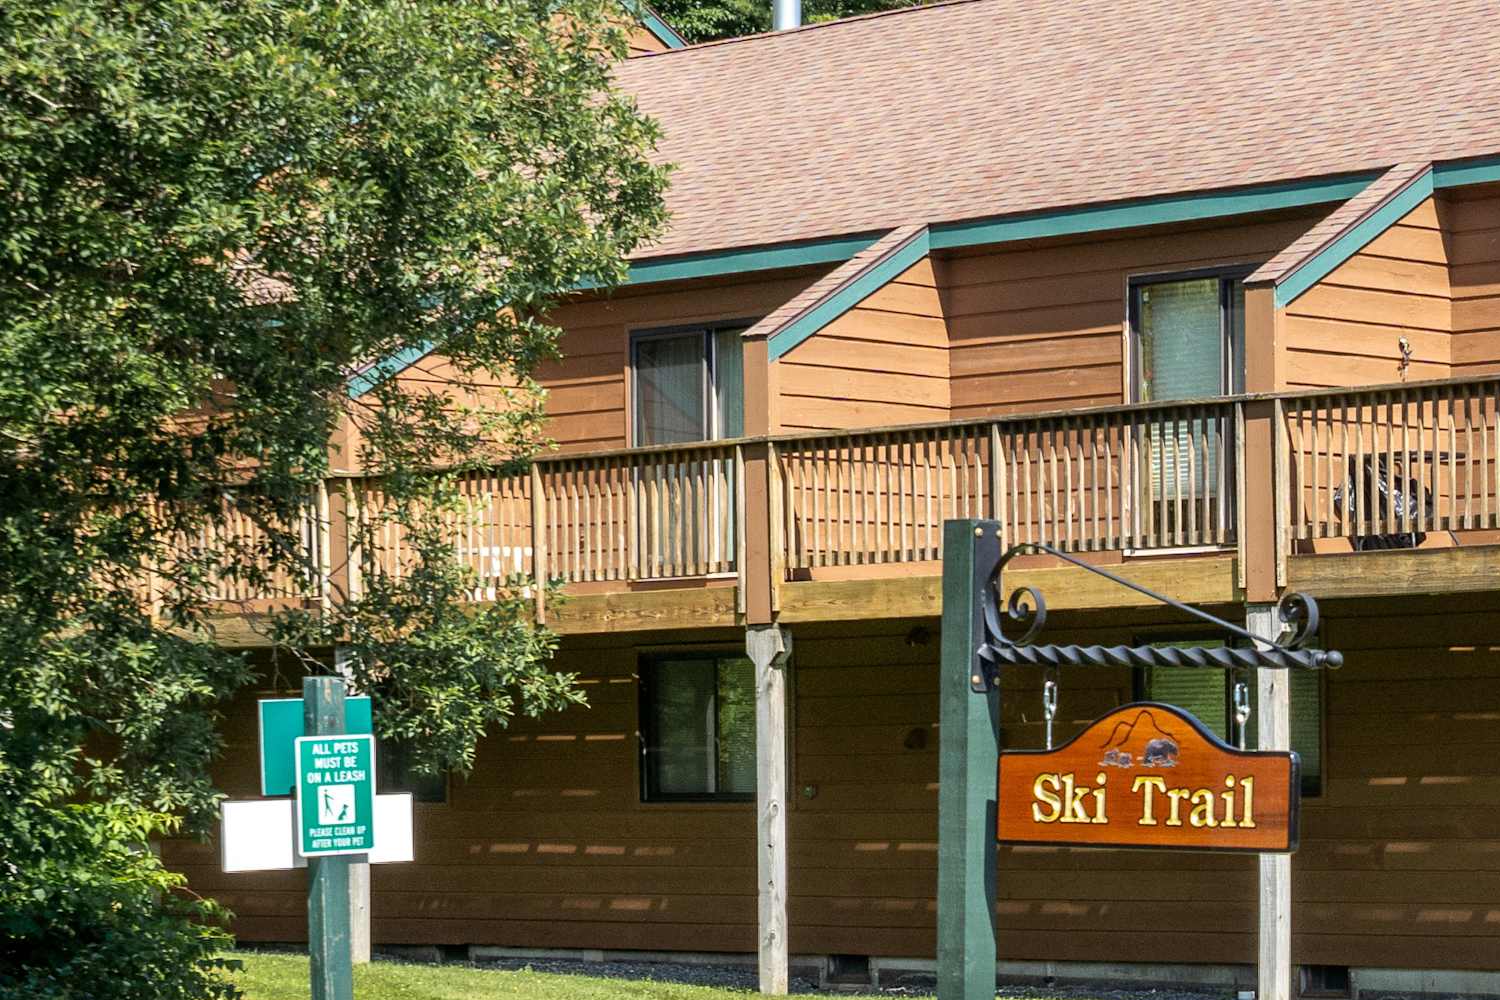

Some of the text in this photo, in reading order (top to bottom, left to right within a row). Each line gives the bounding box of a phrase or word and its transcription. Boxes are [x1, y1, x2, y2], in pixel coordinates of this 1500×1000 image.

[312, 742, 359, 755] ALL PETS
[314, 756, 357, 769] MUST BE
[307, 770, 365, 784] ON A LEASH
[1032, 771, 1256, 828] Ski Trail
